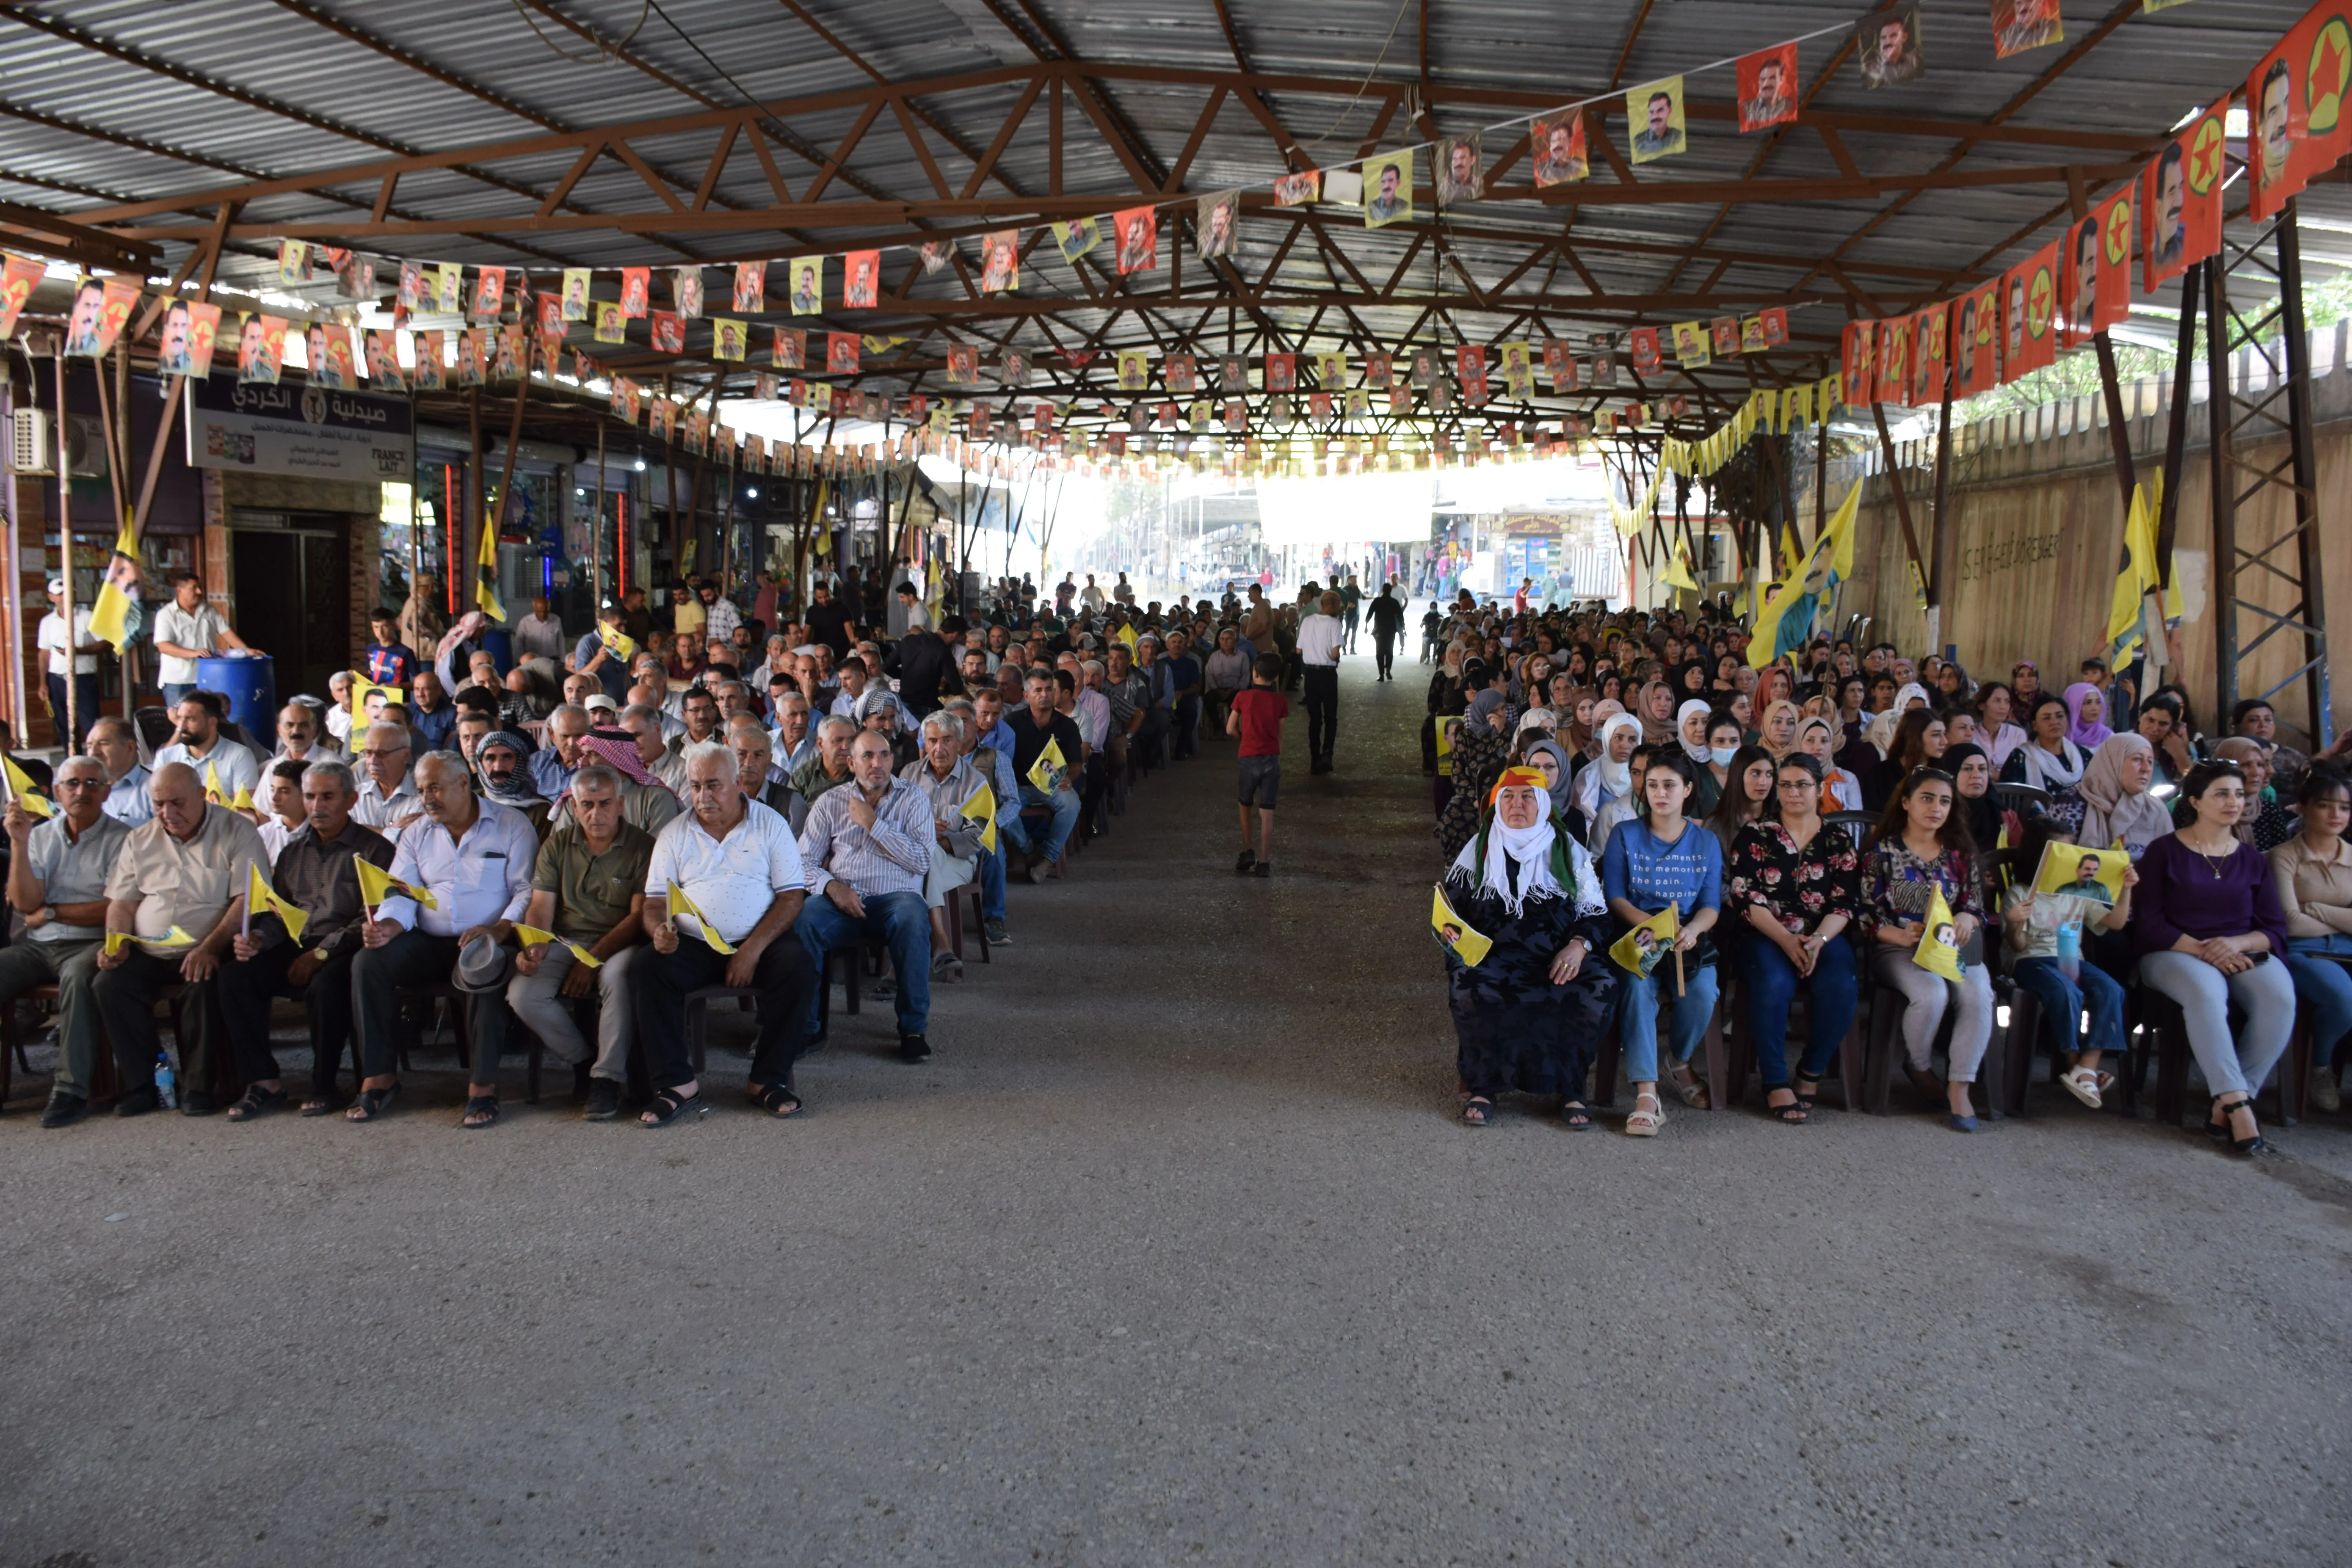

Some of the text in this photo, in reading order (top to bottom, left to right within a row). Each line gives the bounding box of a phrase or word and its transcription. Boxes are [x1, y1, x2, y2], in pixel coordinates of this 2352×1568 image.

[231, 386, 387, 423] صيدلية الكردي
[372, 448, 405, 461] FRANCE
[379, 460, 398, 471] LAIT
